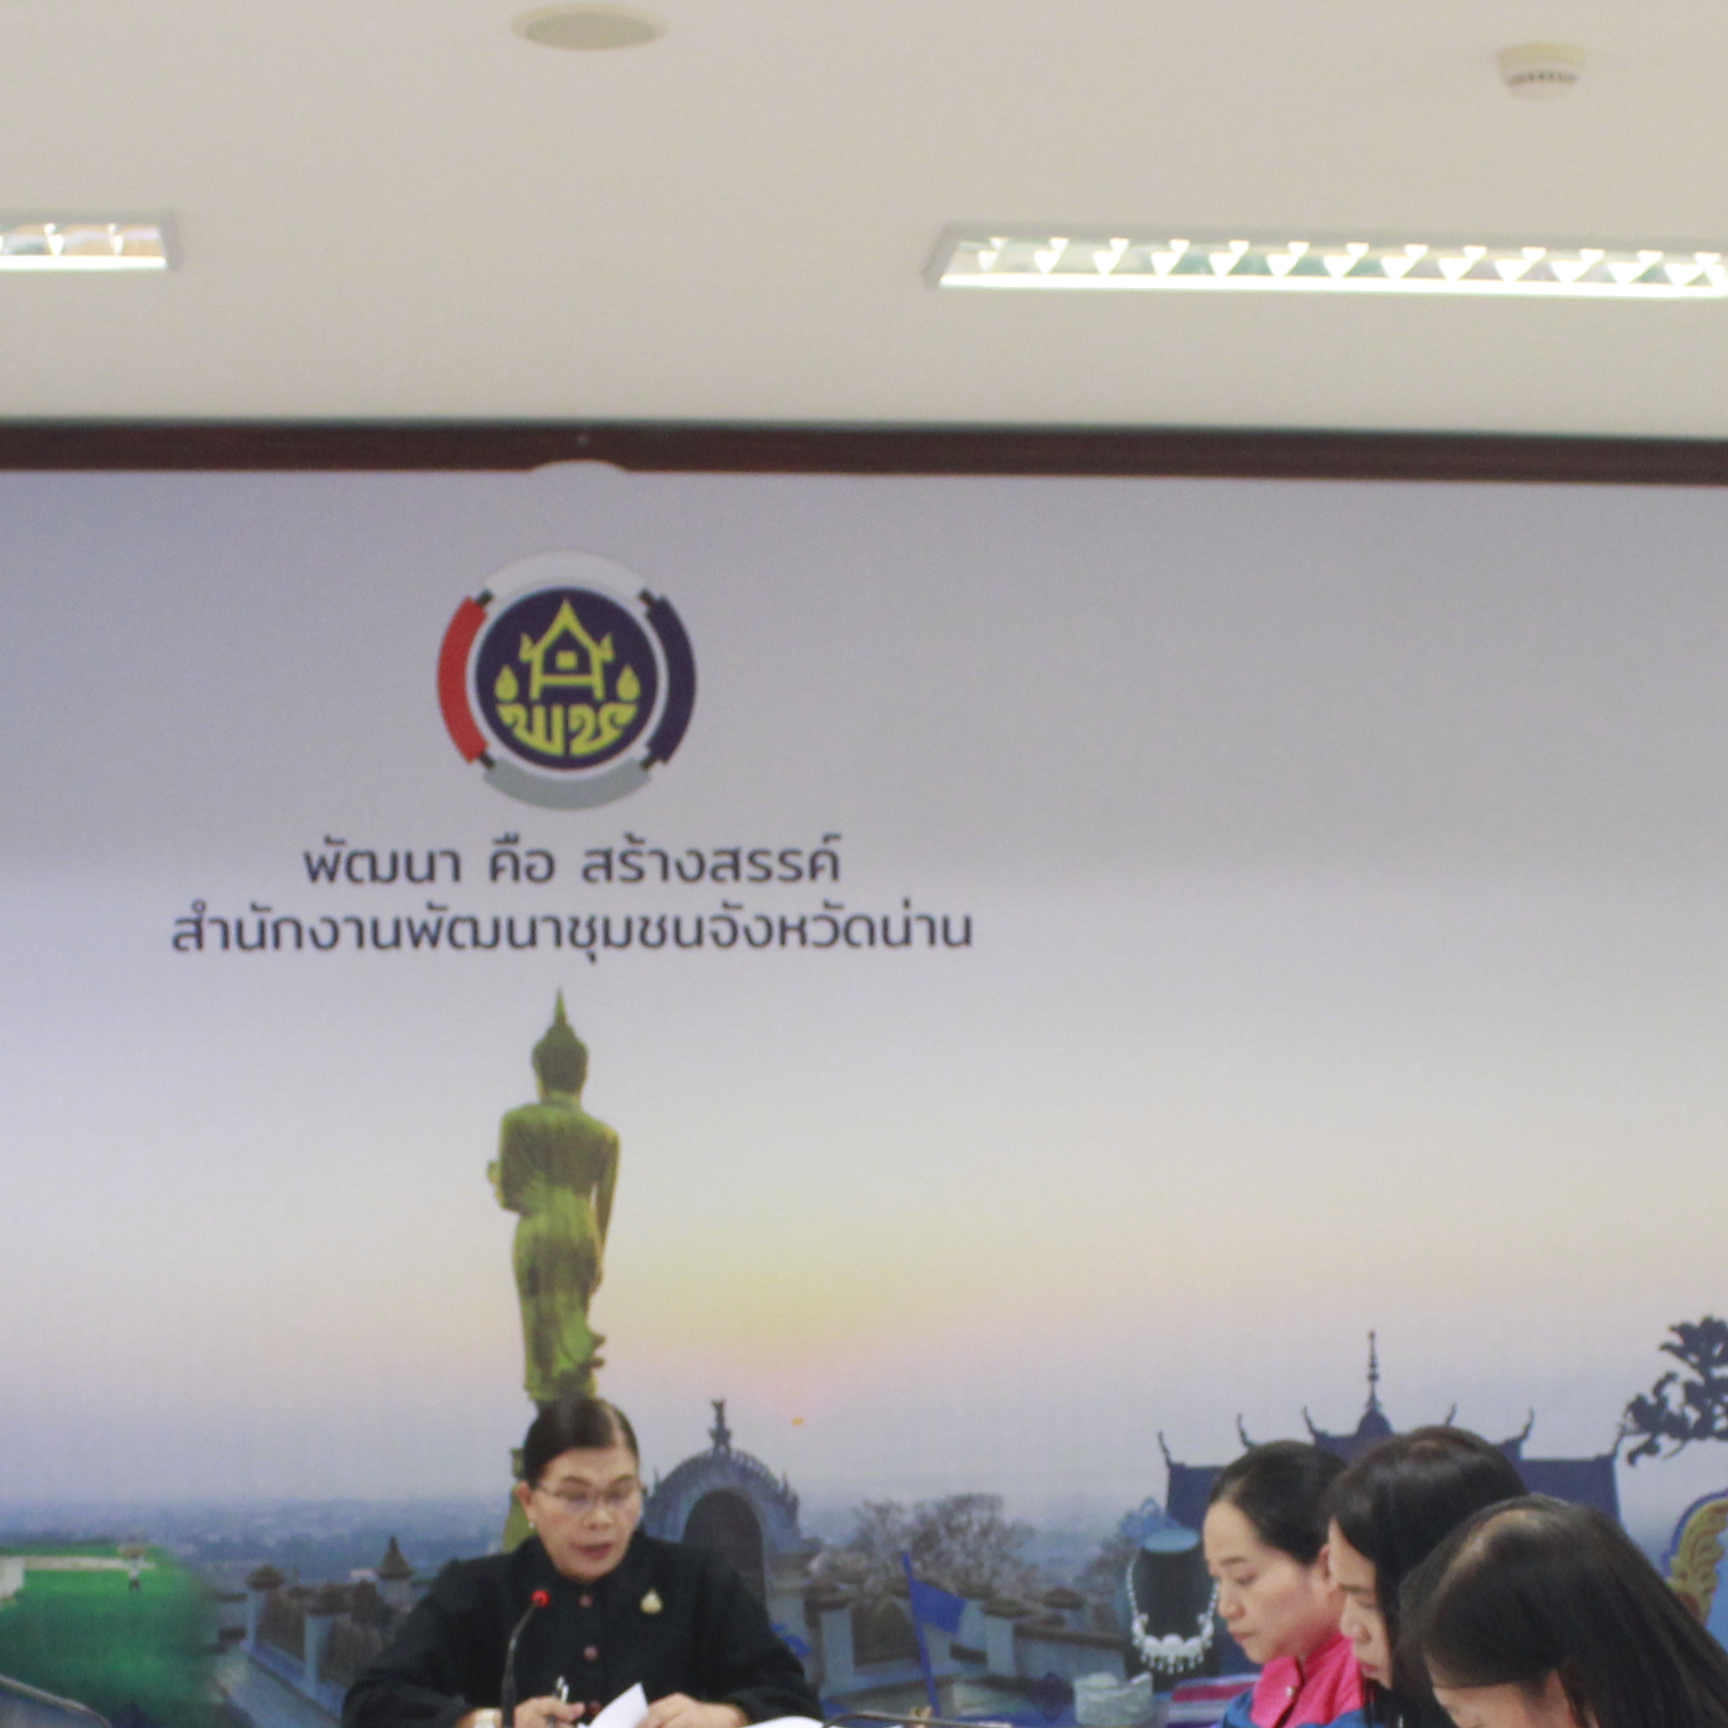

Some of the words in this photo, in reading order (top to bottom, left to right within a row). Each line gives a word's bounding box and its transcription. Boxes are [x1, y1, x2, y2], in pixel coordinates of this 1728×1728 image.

[303, 834, 463, 884] พัฒนา
[488, 832, 558, 884] คือ
[581, 832, 843, 884] สร้างสรรค์
[171, 899, 973, 964] สำนักงานพัฒนาชุมชนจังหวัดน่าน
